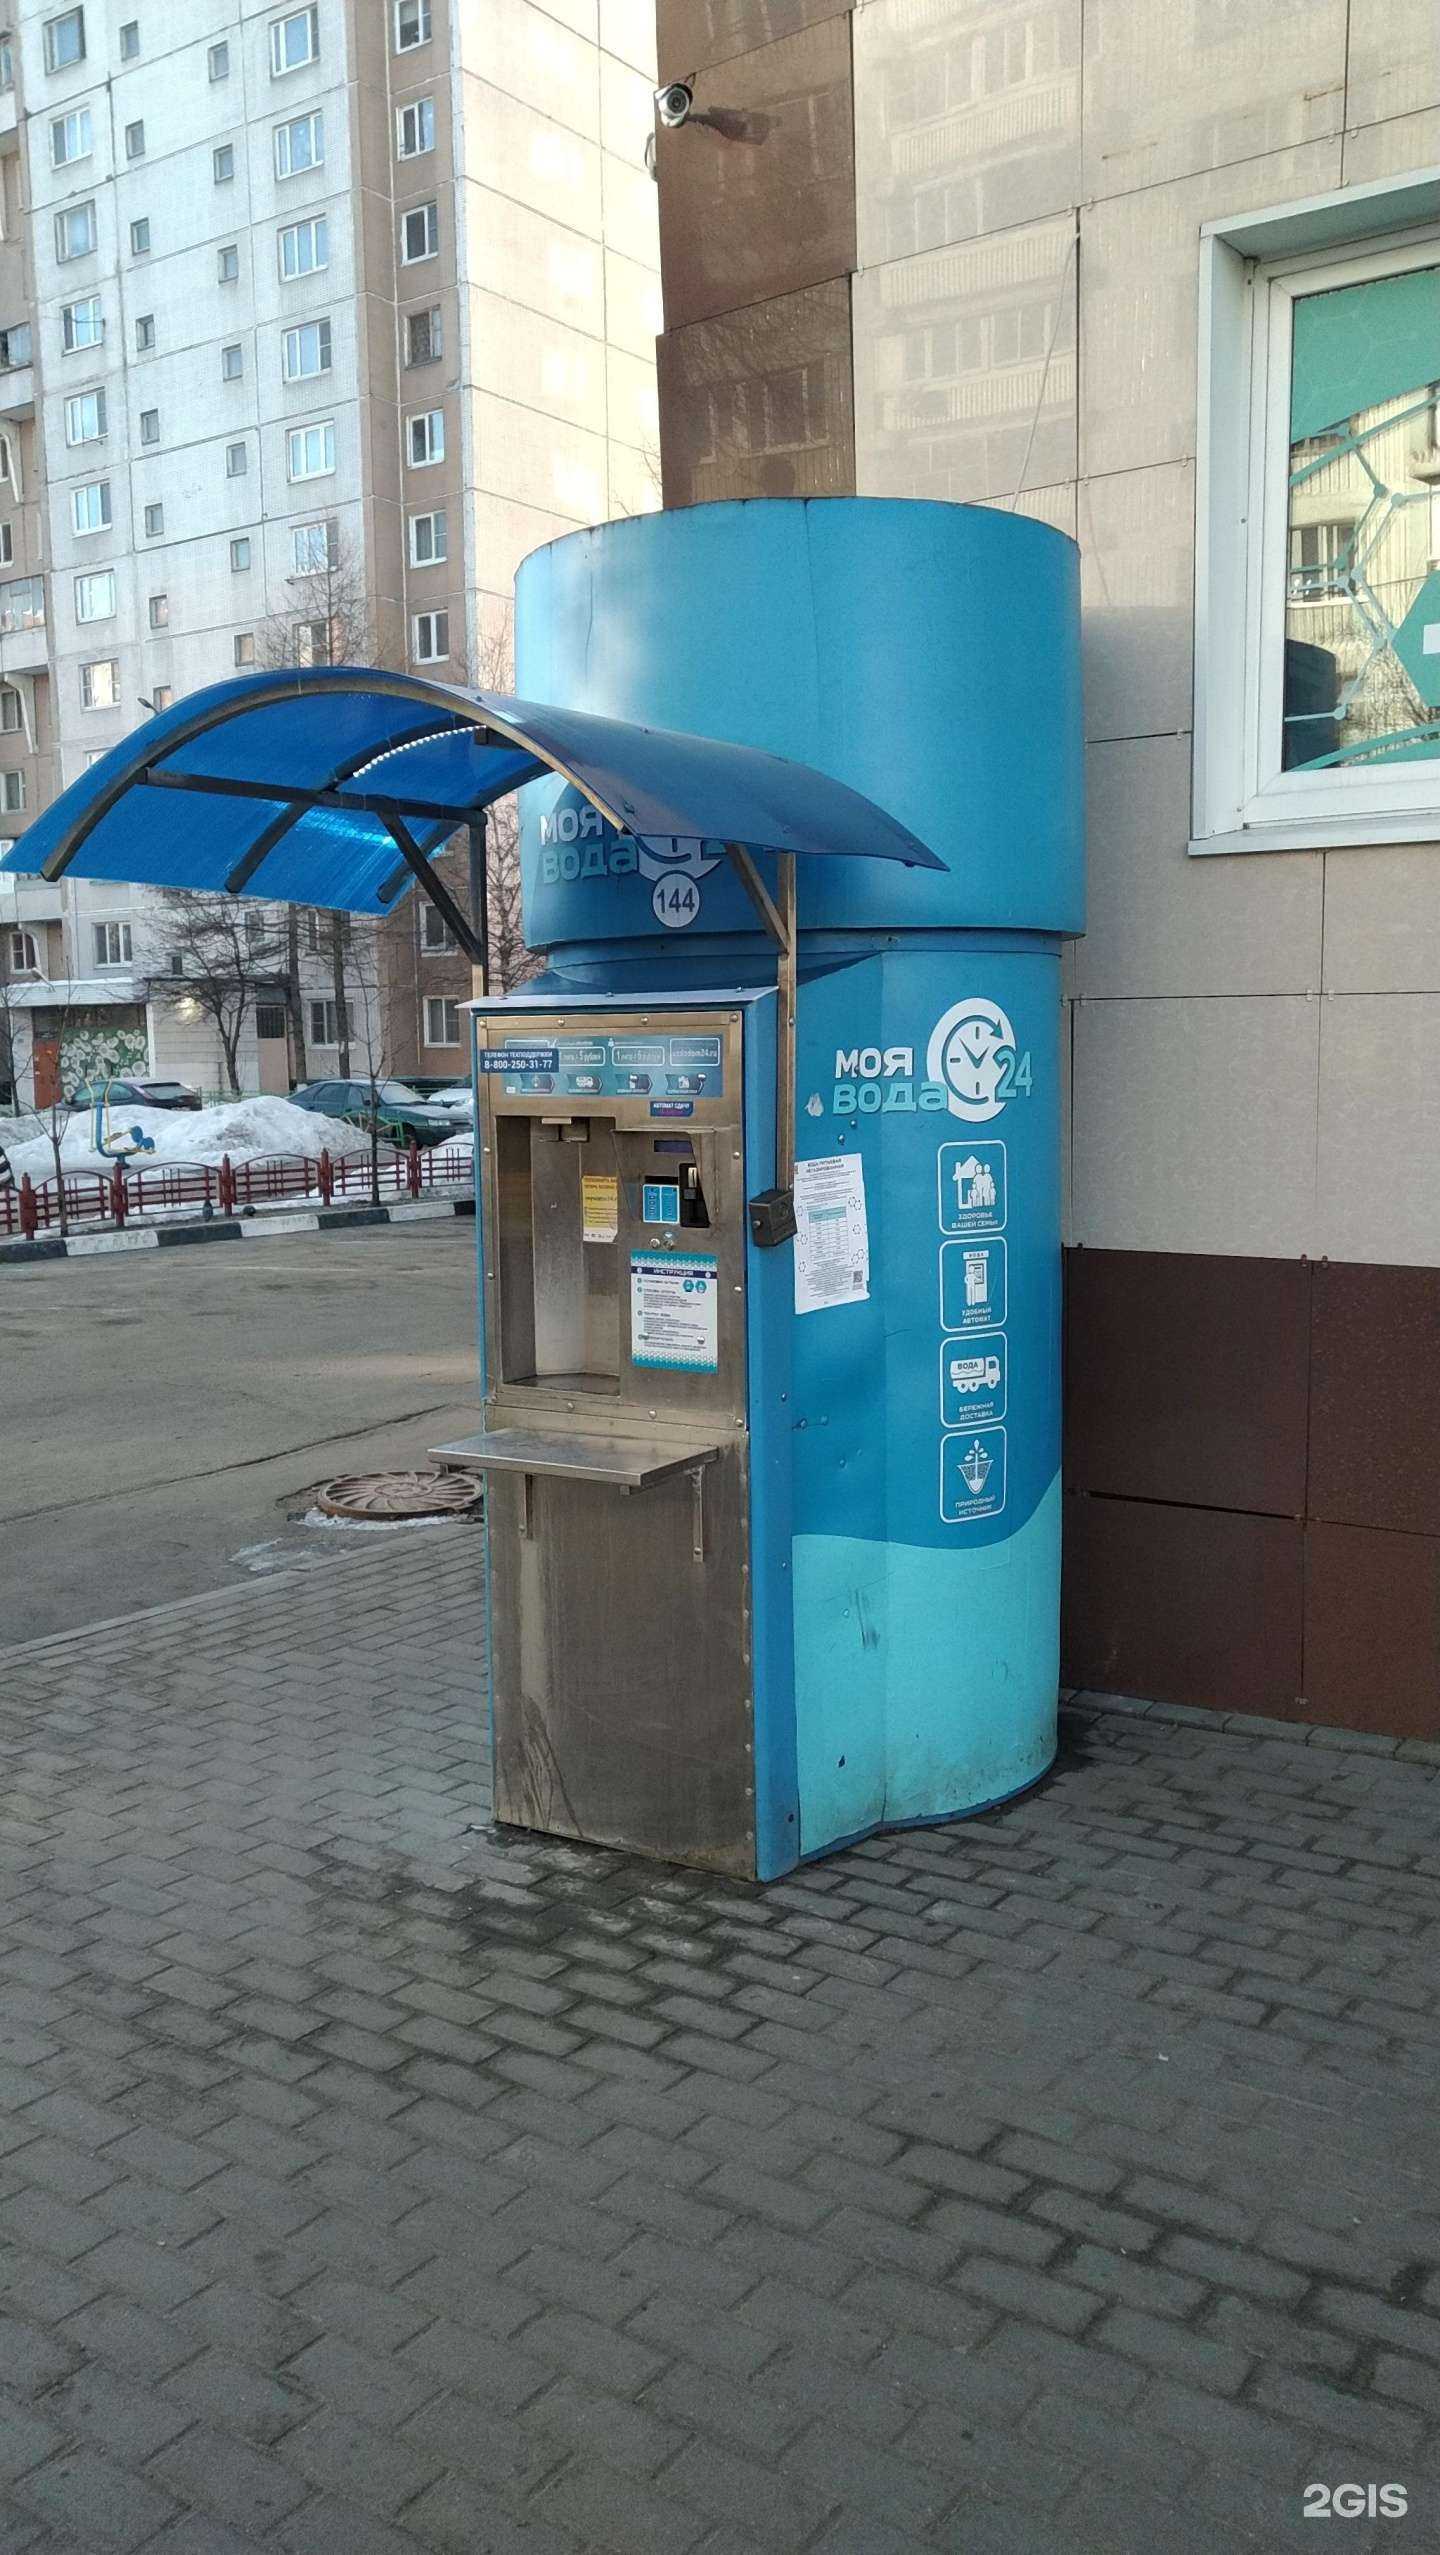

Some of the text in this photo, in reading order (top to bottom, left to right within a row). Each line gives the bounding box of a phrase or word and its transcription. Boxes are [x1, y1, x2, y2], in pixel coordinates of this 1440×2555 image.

[656, 887, 696, 914] 144
[510, 1051, 553, 1059] ТЕХПОДДЕРЖКИ
[484, 1059, 553, 1070] 8-800-250-31-77
[835, 1046, 914, 1079] МОЯ
[997, 1049, 1033, 1099] 24
[958, 1212, 993, 1220] ЗДОРОВЬЕ
[951, 1221, 976, 1229] ВАШЕЙ
[653, 1267, 694, 1276] ИНСТРУКЦИЯ
[962, 1308, 992, 1318] УДОБНЫЙ
[962, 1316, 991, 1325] АВТОМАТ
[957, 1361, 979, 1371] ВОДА
[959, 1401, 994, 1413] БЕРЕЖНАЯ
[960, 1410, 993, 1421] ДОСТАВКА
[955, 1495, 996, 1508] ПРИРОДНЫЙ
[958, 1504, 993, 1516] ИСТОЧНИК
